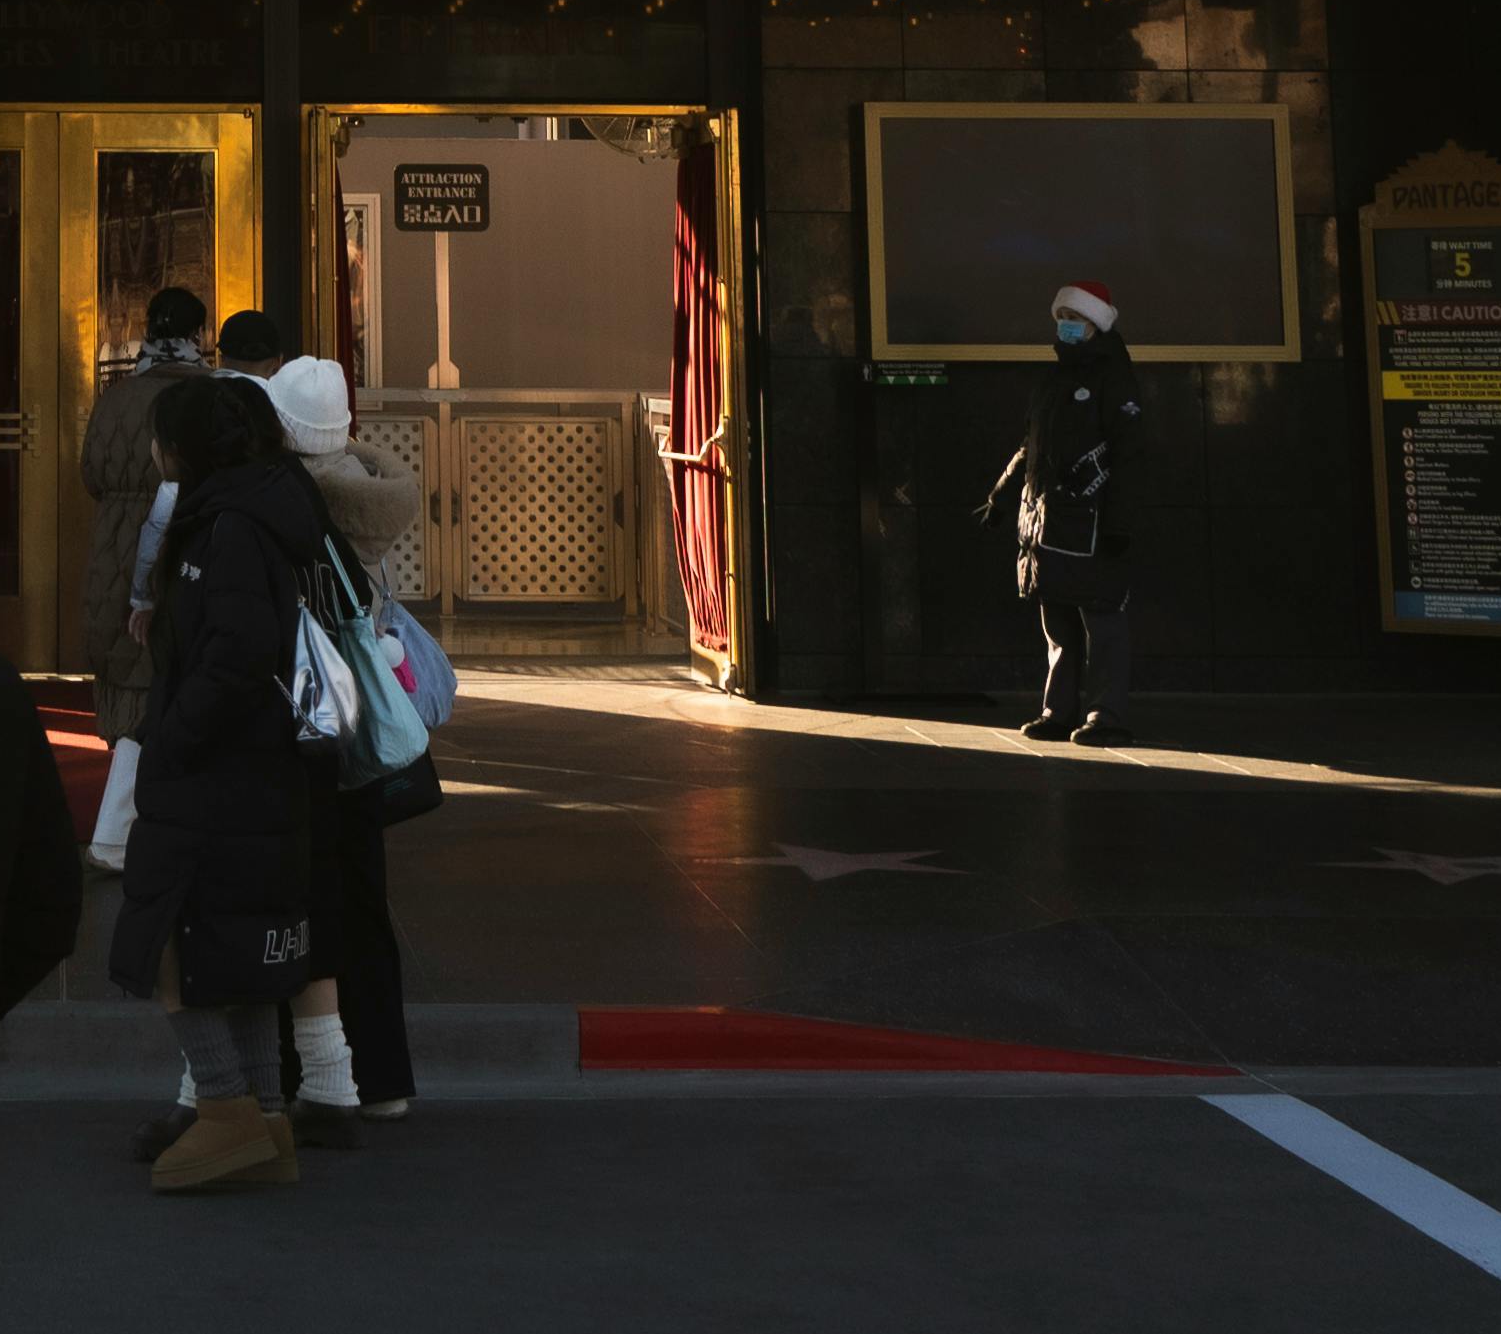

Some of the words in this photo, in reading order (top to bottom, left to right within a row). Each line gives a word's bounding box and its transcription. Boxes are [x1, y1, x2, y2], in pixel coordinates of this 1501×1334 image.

[87, 37, 226, 67] THEATRE
[400, 172, 483, 184] ATTRACTION
[407, 186, 476, 198] ENTRANCE
[403, 204, 481, 224] 景点入口
[1448, 241, 1470, 250] WAIT
[1472, 241, 1493, 250] TIME
[1453, 251, 1472, 277] 5
[1454, 279, 1493, 289] MINUTES
